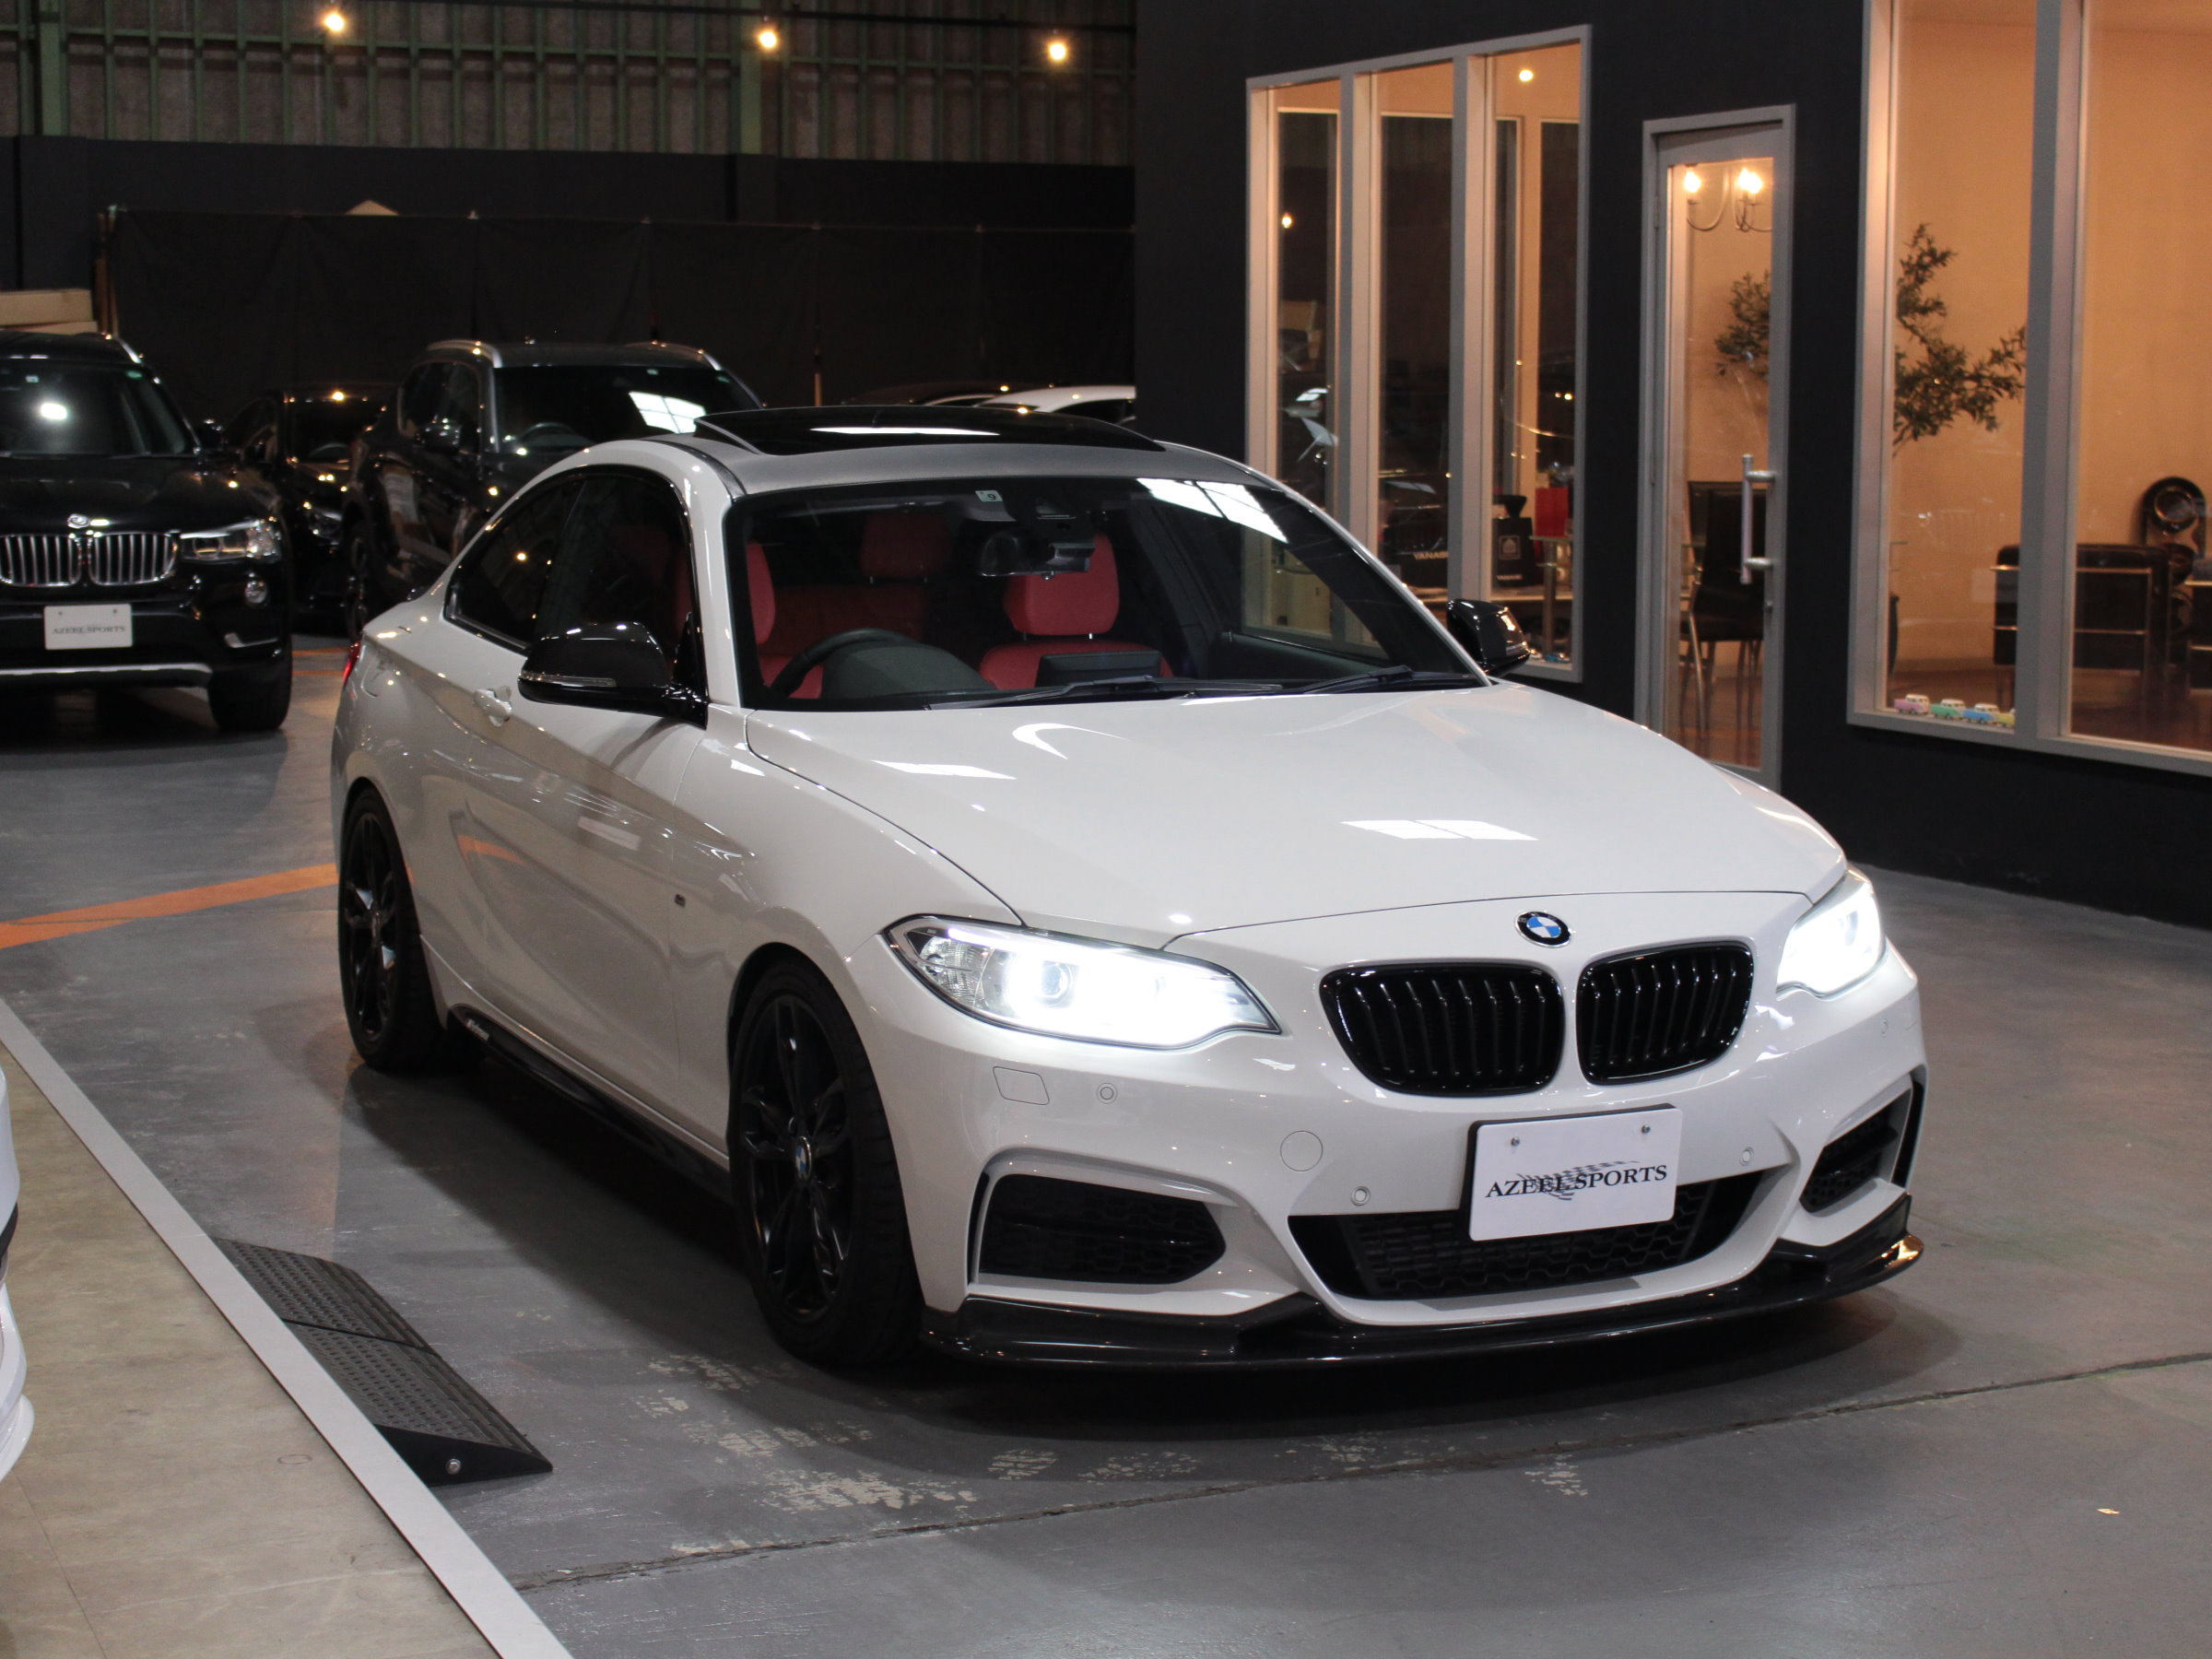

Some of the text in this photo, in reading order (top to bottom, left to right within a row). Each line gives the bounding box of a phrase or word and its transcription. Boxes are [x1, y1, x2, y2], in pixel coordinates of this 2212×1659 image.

[87, 625, 126, 633] SPORTS
[1484, 1164, 1667, 1198] AZEEL SPORTS
